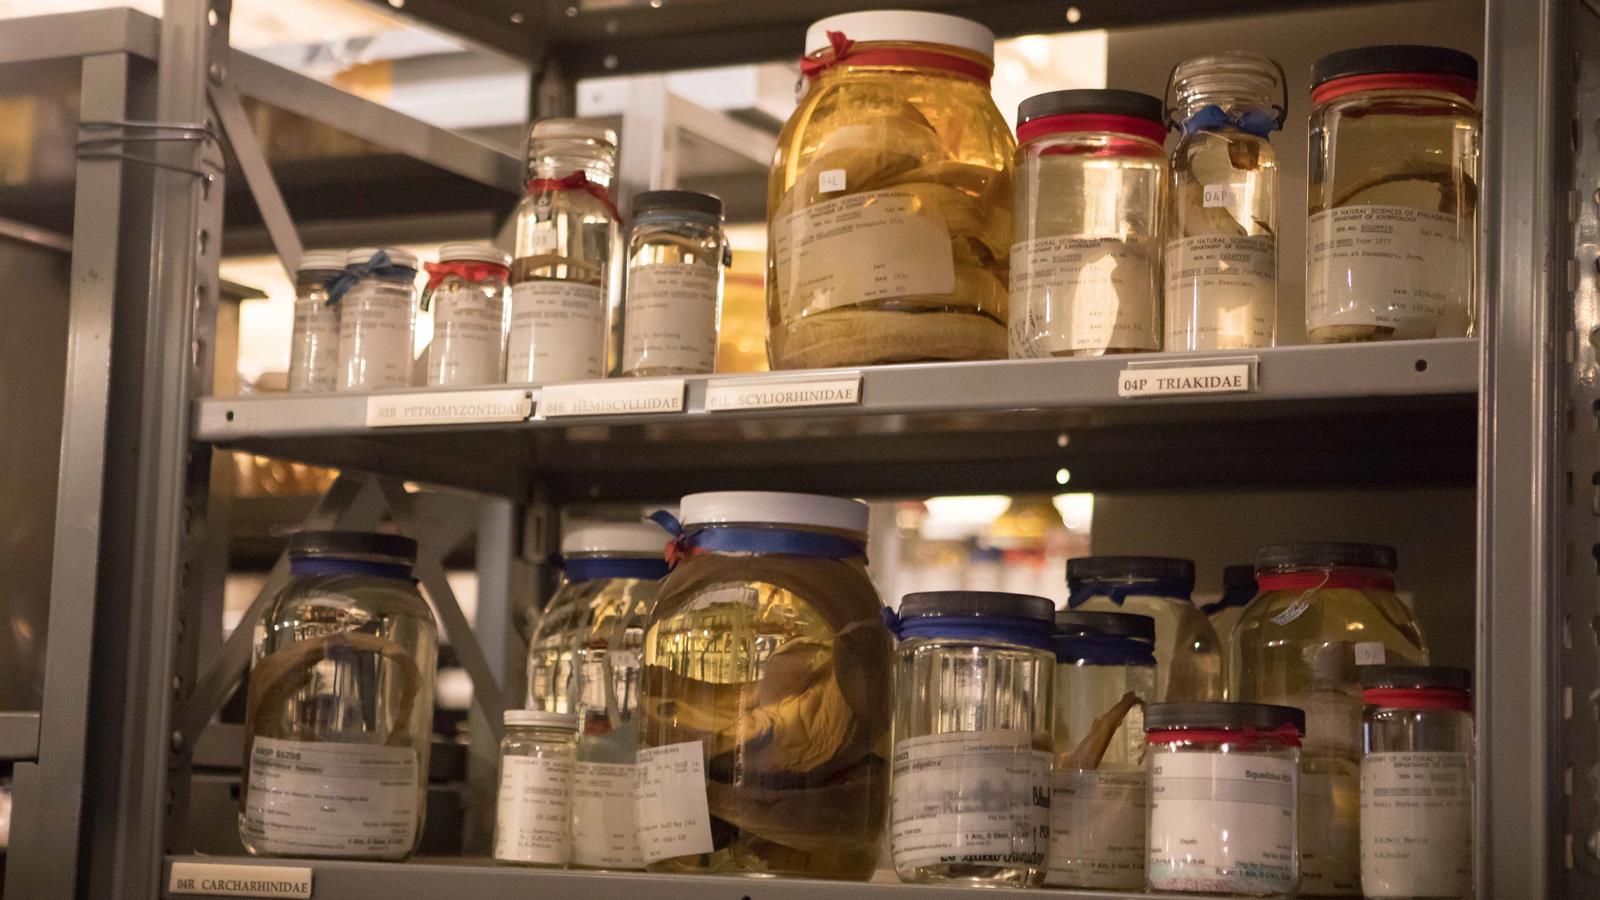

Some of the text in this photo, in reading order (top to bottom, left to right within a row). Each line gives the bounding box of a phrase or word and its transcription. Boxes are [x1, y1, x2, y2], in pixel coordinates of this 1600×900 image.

[1205, 191, 1227, 202] 04P
[1124, 375, 1242, 392] 04P TRIAKIDAE
[738, 388, 853, 406] SCYLIORHINIDAE
[403, 403, 523, 417] PETROMYZONTIDAE
[177, 879, 308, 893] 04R CARCHARHINIDAE
